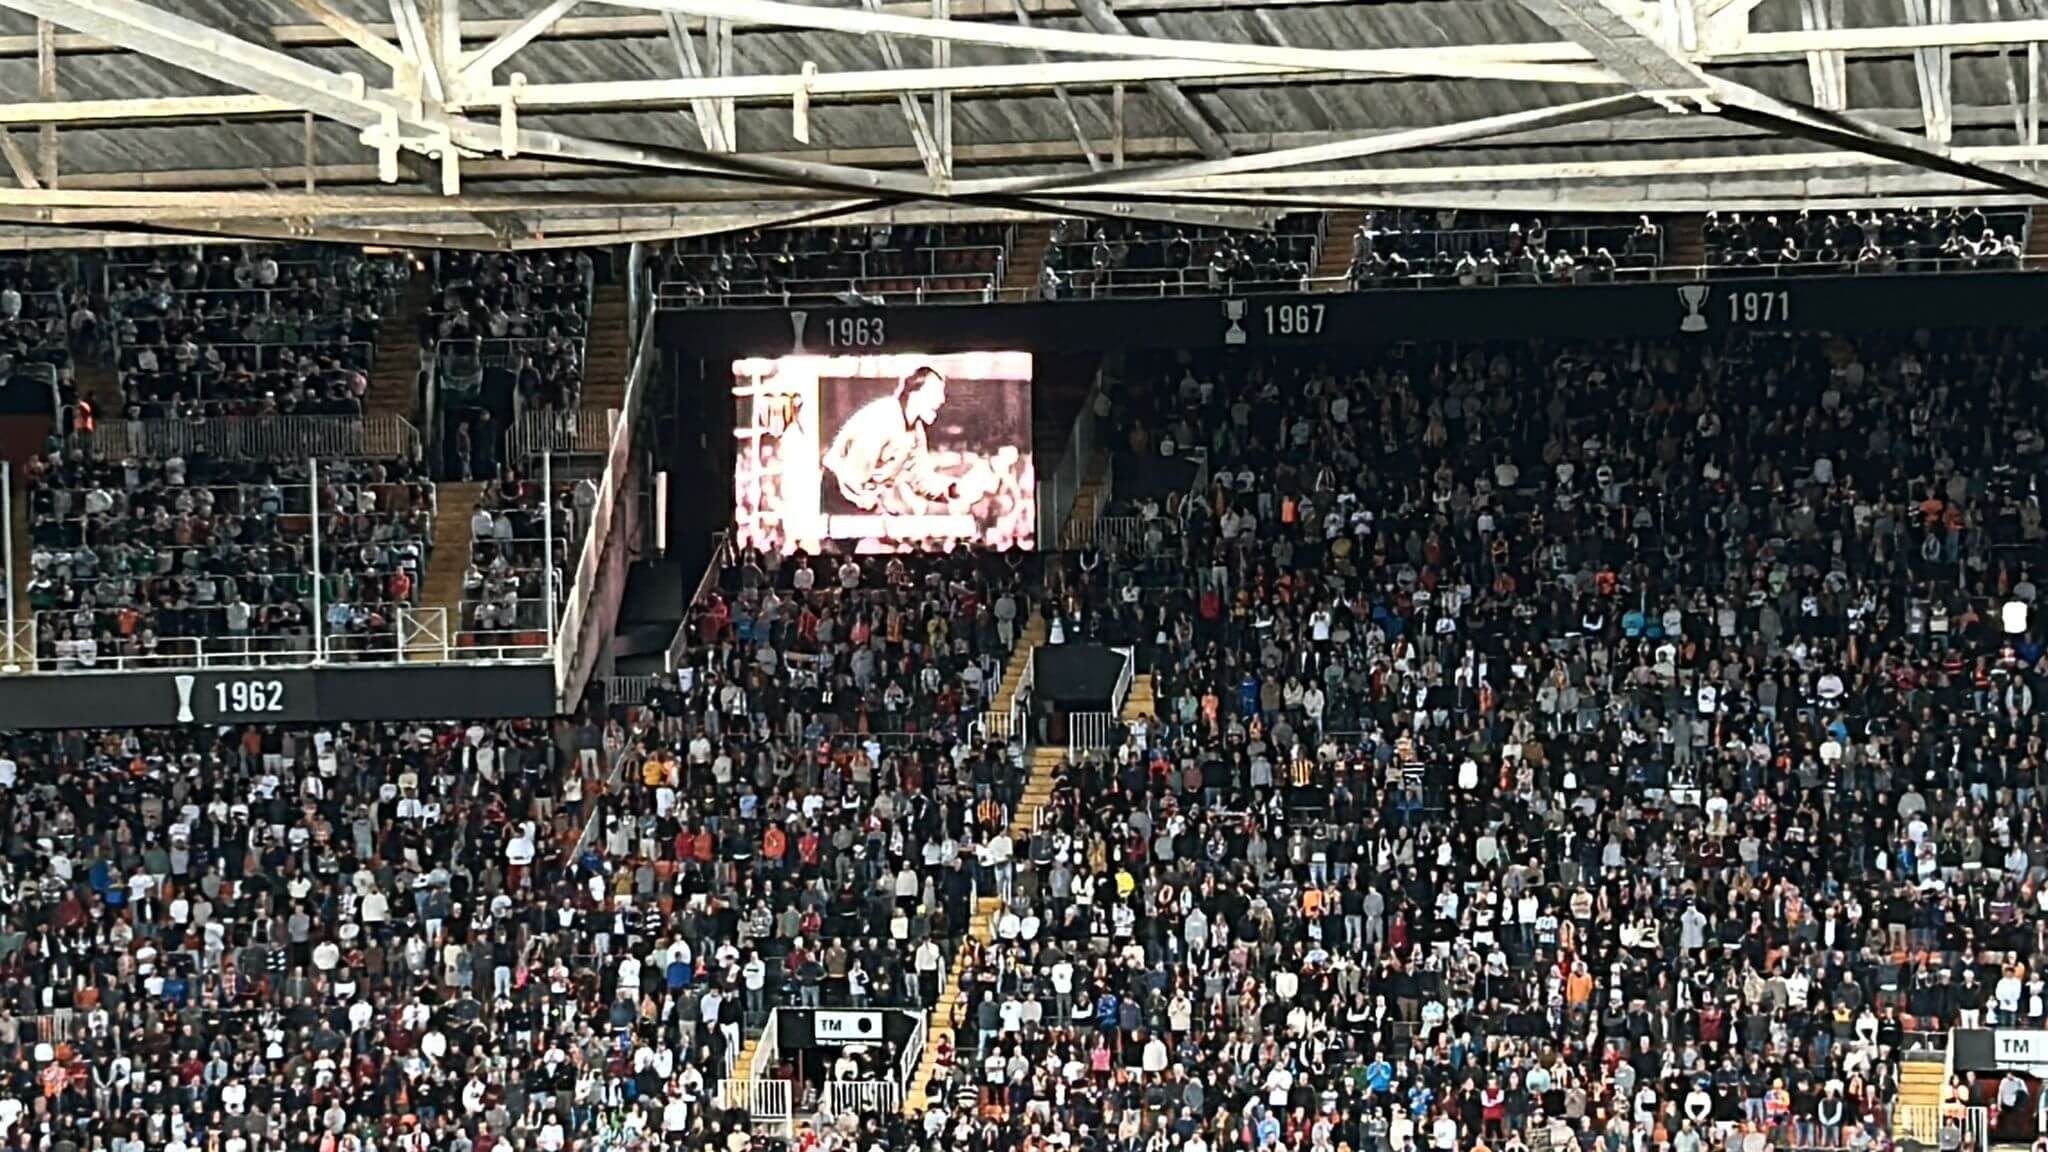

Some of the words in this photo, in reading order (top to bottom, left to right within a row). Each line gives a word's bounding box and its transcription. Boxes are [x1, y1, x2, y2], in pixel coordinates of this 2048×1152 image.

[1265, 304, 1325, 334] 1967
[1728, 291, 1789, 322] 1971
[826, 318, 884, 346] 1963
[215, 680, 283, 712] 1962
[2003, 1039, 2029, 1053] TM
